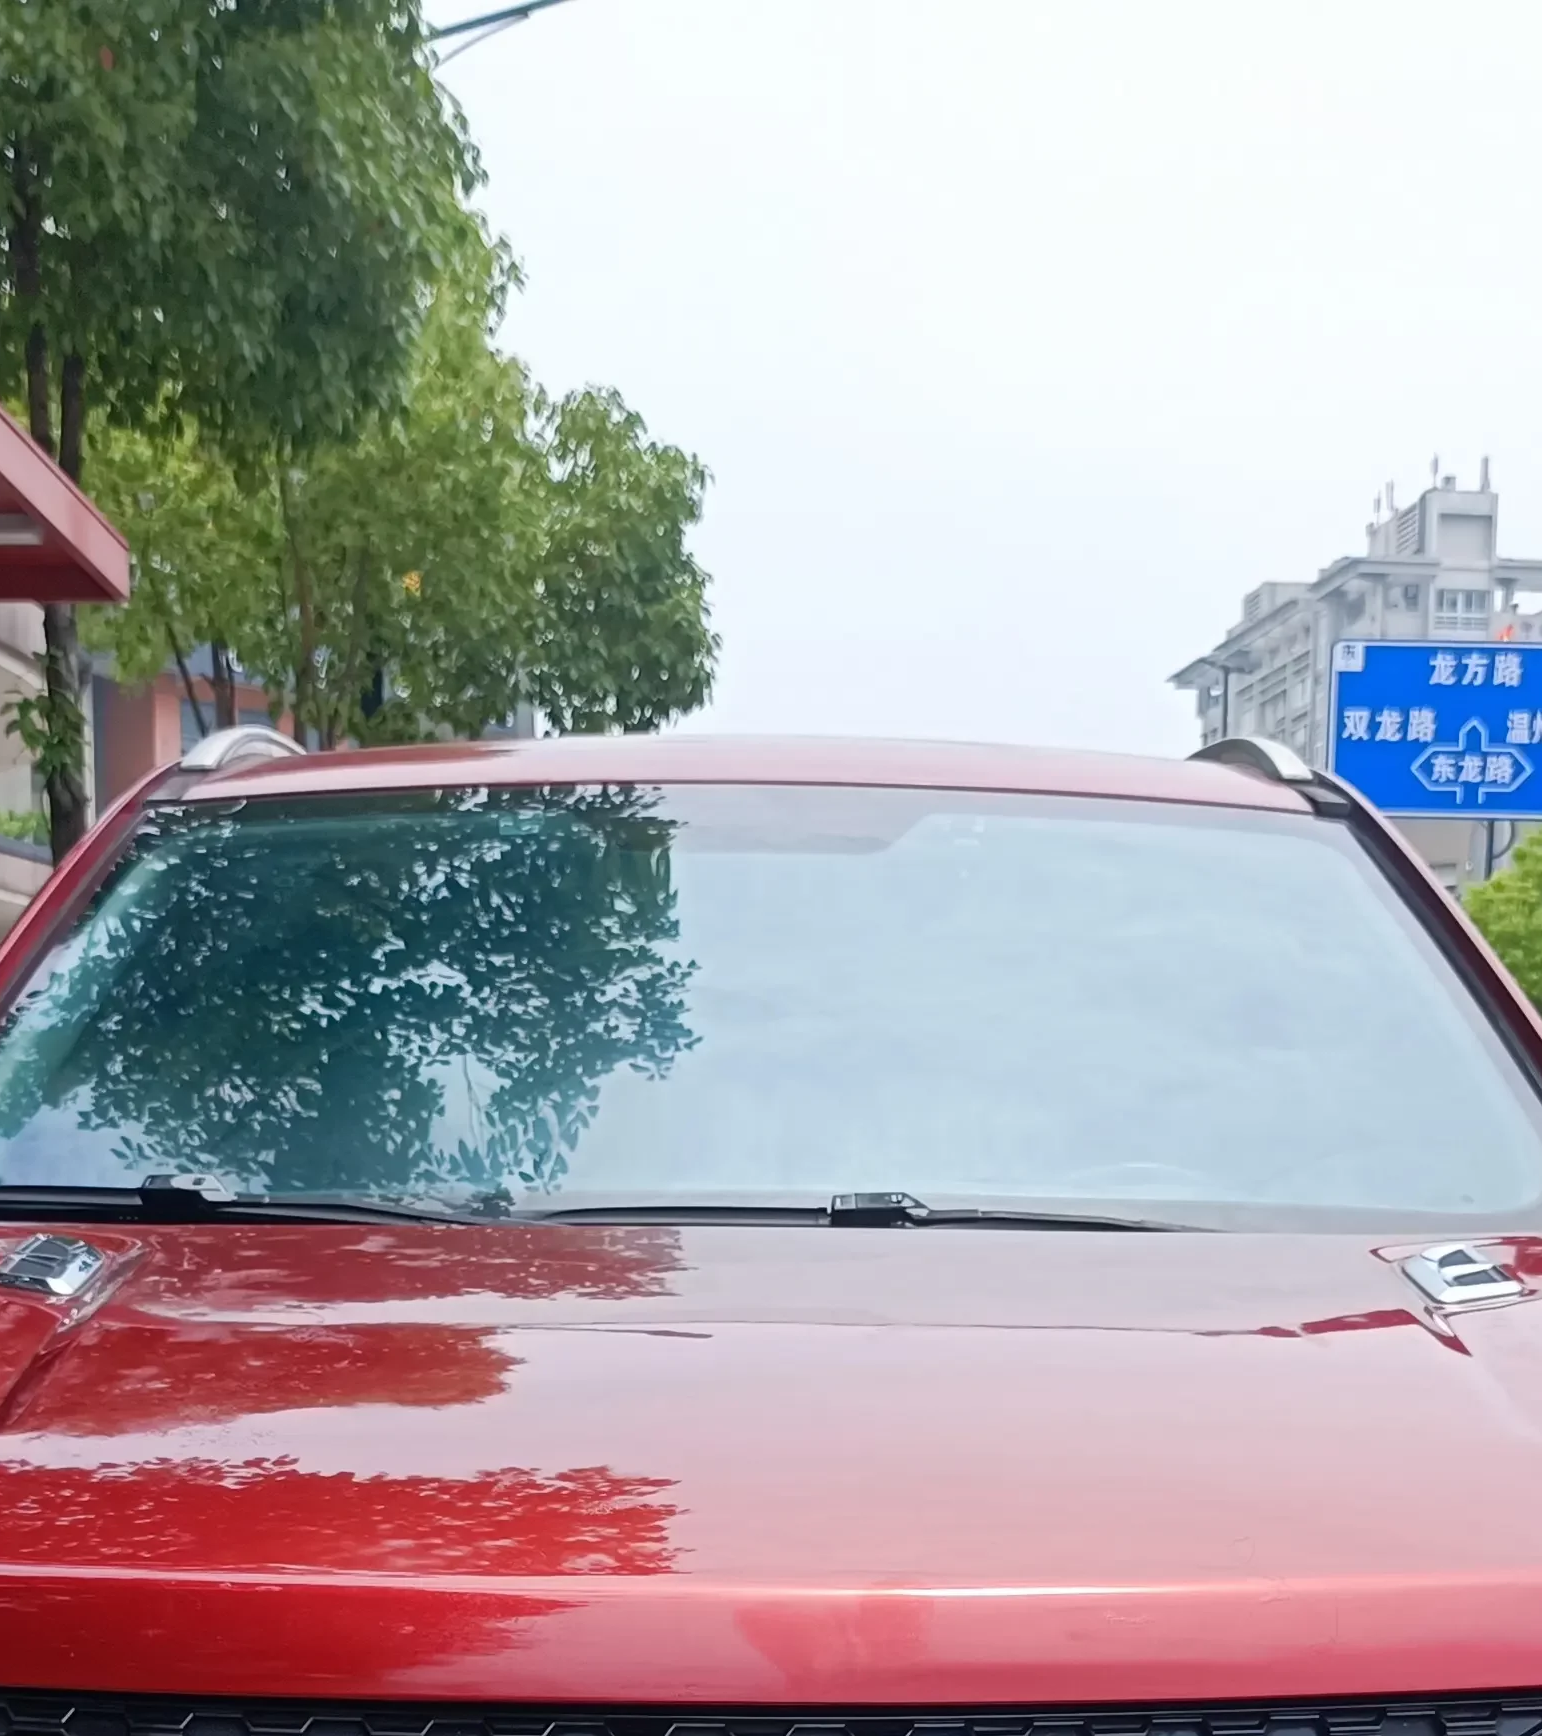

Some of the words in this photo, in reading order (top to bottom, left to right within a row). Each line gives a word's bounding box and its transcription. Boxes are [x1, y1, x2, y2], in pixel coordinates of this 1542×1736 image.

[1429, 651, 1523, 687] 龙方路
[1342, 706, 1437, 743] 双龙路
[1431, 754, 1515, 784] 东龙路
